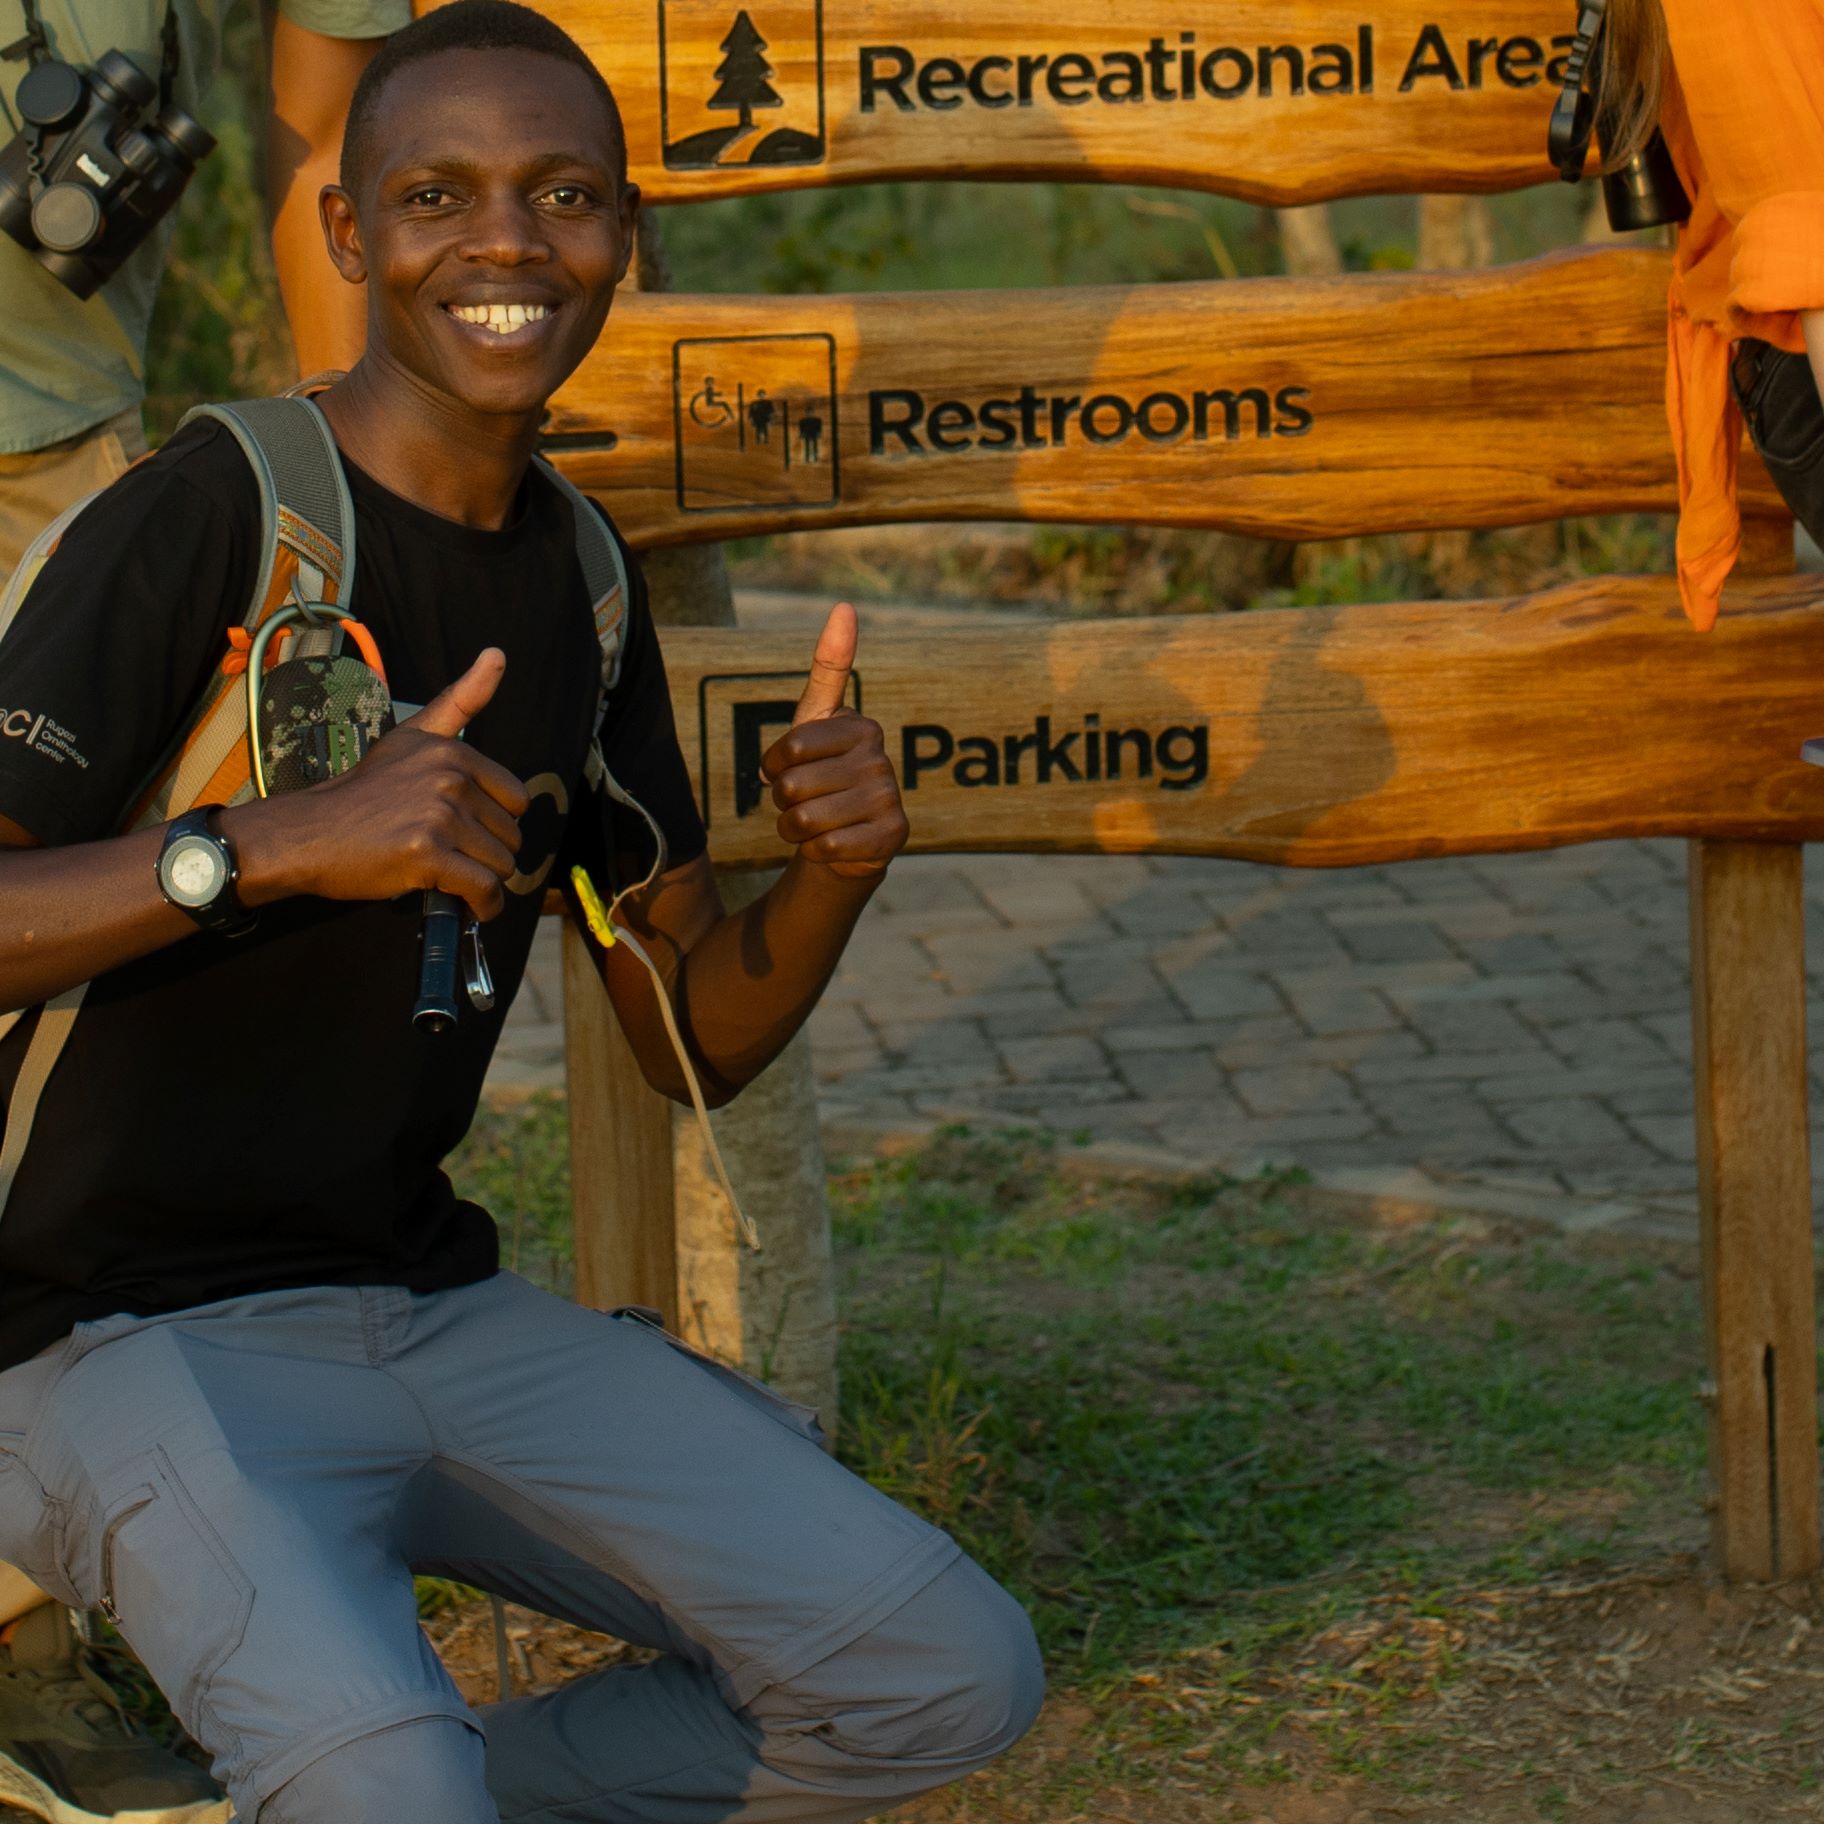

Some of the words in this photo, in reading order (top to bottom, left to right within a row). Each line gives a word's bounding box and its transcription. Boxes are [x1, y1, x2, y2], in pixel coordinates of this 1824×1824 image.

[857, 23, 1376, 114] Recreational
[865, 382, 1316, 457] Restrooms
[898, 710, 1211, 794] Parking
